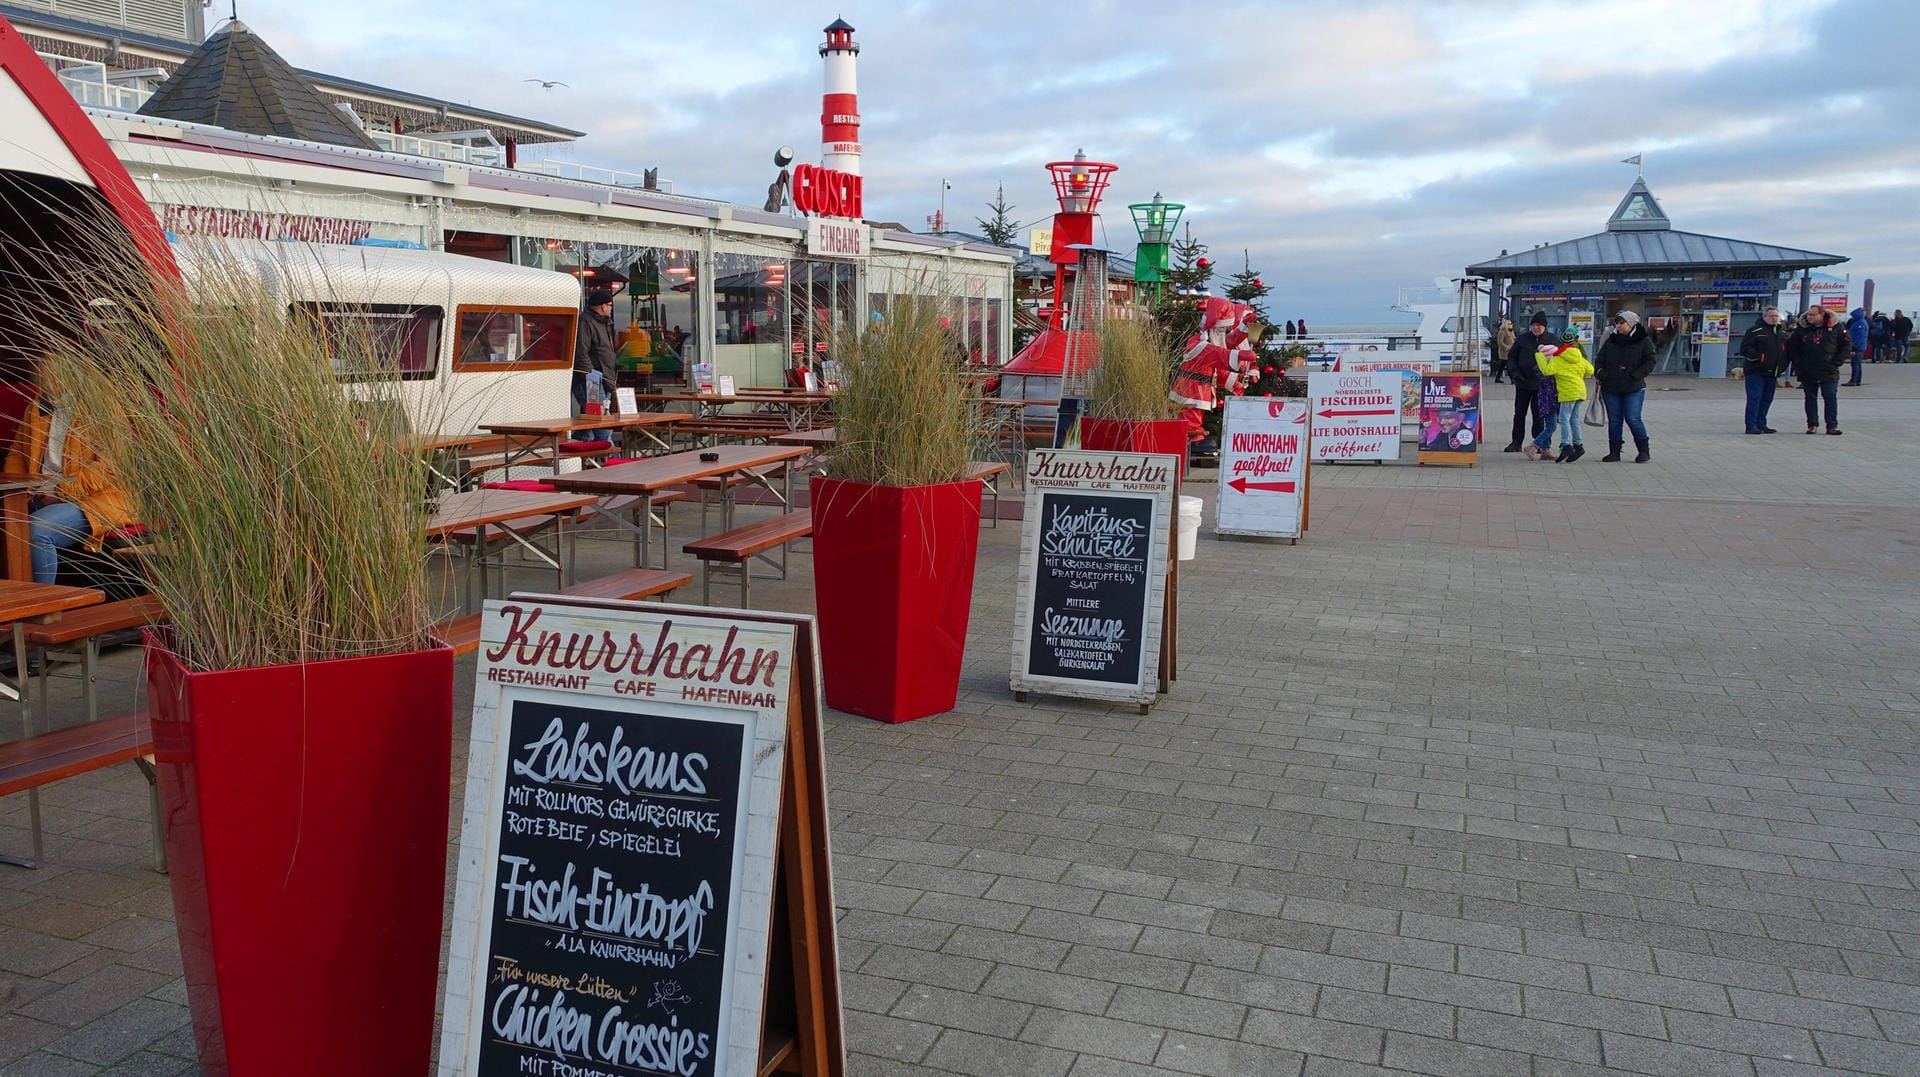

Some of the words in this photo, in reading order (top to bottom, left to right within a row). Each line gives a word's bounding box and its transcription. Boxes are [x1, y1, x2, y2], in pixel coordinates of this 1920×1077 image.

[792, 163, 864, 219] GOSCH
[819, 224, 860, 255] EINGANG
[1339, 376, 1372, 388] GOSCH
[1320, 395, 1393, 406] FISCHBUDE
[1333, 425, 1399, 437] BOOTSHALLE
[1232, 433, 1298, 454] KNURRHAHN
[1320, 441, 1382, 458] geöffnet!
[1029, 452, 1168, 483] Knurrhahn
[1232, 454, 1294, 477] geöffnet!
[1030, 479, 1079, 488] RESTAURANT
[1091, 481, 1111, 489] CAFE
[1123, 482, 1167, 492] HAFENBAR
[1042, 530, 1135, 558] Schnitzel
[1045, 556, 1060, 567] MIT
[1069, 580, 1099, 590] SALAT
[1066, 598, 1101, 609] MITTLERE
[1041, 607, 1125, 641] Seezunge
[486, 605, 780, 688] Knurrhahn
[1046, 636, 1058, 646] MIT
[1059, 657, 1106, 671] GURKENSALAT
[488, 667, 590, 690] RESTAURANT
[613, 678, 657, 697] CAFE
[682, 684, 777, 709] HAFENBAR
[513, 717, 709, 795] Labskaus
[507, 785, 535, 807] MIT
[608, 798, 721, 838] GEWÜRZGURKE,
[506, 810, 545, 835] ROTE
[599, 828, 682, 858] SPIEGELEI
[500, 854, 714, 958] Fisch-Eintopf
[526, 969, 575, 991] unsere
[492, 983, 592, 1061] Chicken
[597, 1004, 710, 1077] Crossies
[520, 1053, 549, 1076] MIT
